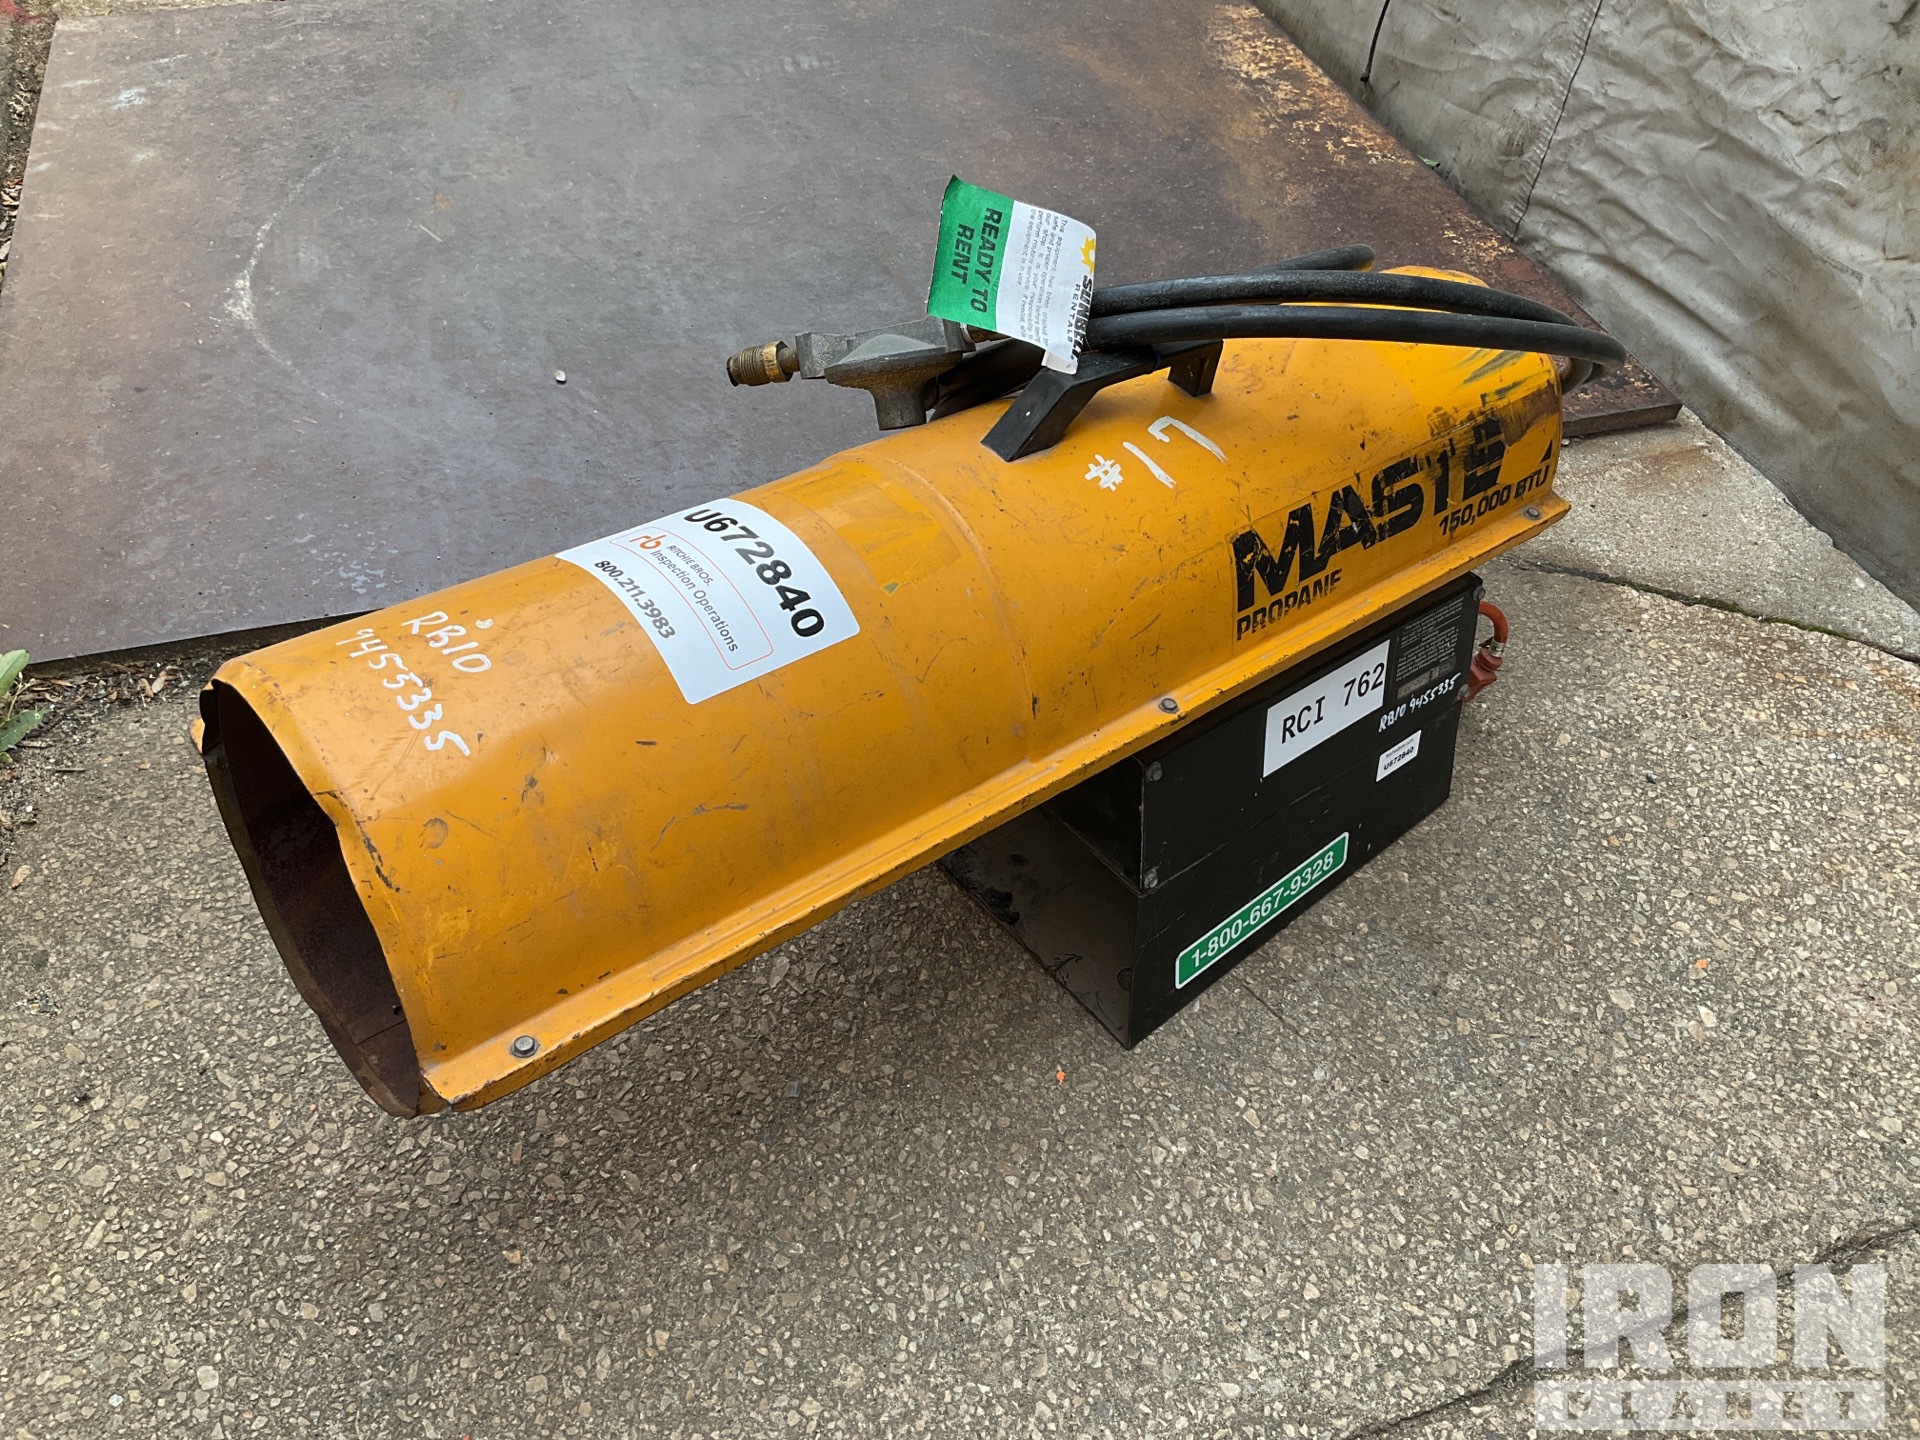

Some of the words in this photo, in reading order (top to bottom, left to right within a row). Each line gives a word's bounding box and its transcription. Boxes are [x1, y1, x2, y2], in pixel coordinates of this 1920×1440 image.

[950, 223, 975, 285] RENT
[974, 207, 1003, 284] READY
[970, 288, 988, 313] TO
[1067, 283, 1081, 343] RENTALS
[1085, 415, 1229, 492] #17
[1438, 484, 1512, 536] 150,000
[1513, 464, 1550, 499] BTU
[594, 560, 676, 639] 800.211.3983
[650, 549, 696, 591] Inspection
[693, 589, 739, 653] Operations
[666, 544, 694, 567] RITCHIE
[689, 561, 713, 587] BROS.
[683, 508, 825, 638] U672840
[400, 610, 492, 673] RB10
[335, 628, 471, 756] 9455335
[1281, 695, 1326, 744] RCI
[1343, 662, 1385, 707] 762
[1378, 703, 1407, 732] RB10
[1409, 672, 1461, 713] 9455335
[1191, 850, 1334, 968] 1-800-667-9328
